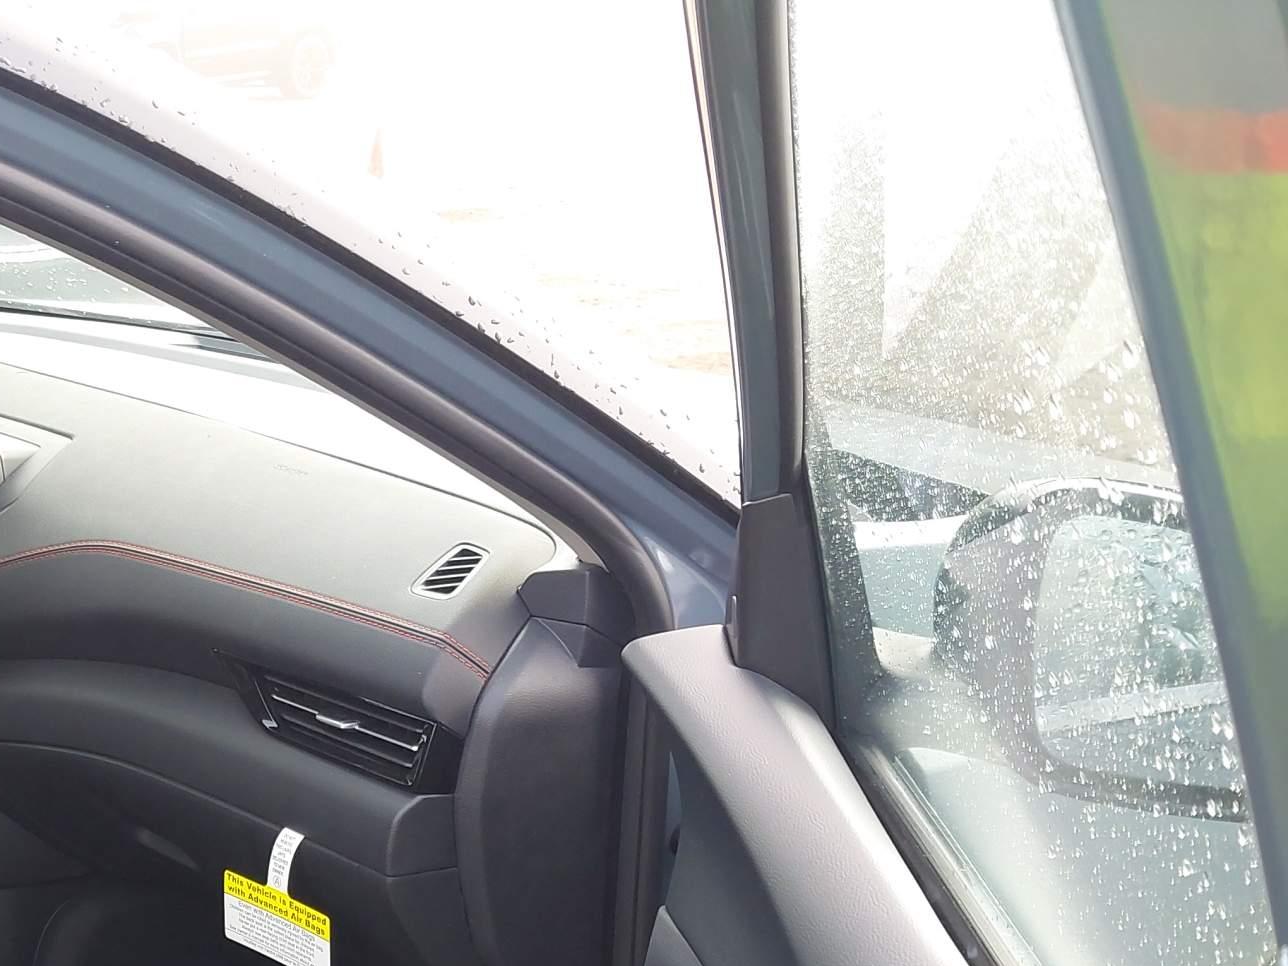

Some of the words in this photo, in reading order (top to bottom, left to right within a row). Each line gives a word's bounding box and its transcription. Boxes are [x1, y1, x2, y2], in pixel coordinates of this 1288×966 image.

[227, 873, 244, 887] This
[246, 882, 277, 901] Vehicle
[289, 901, 327, 926] Equipped
[227, 885, 246, 898] with
[248, 895, 289, 917] Advanced
[291, 913, 303, 924] Air
[305, 919, 326, 936] Bags
